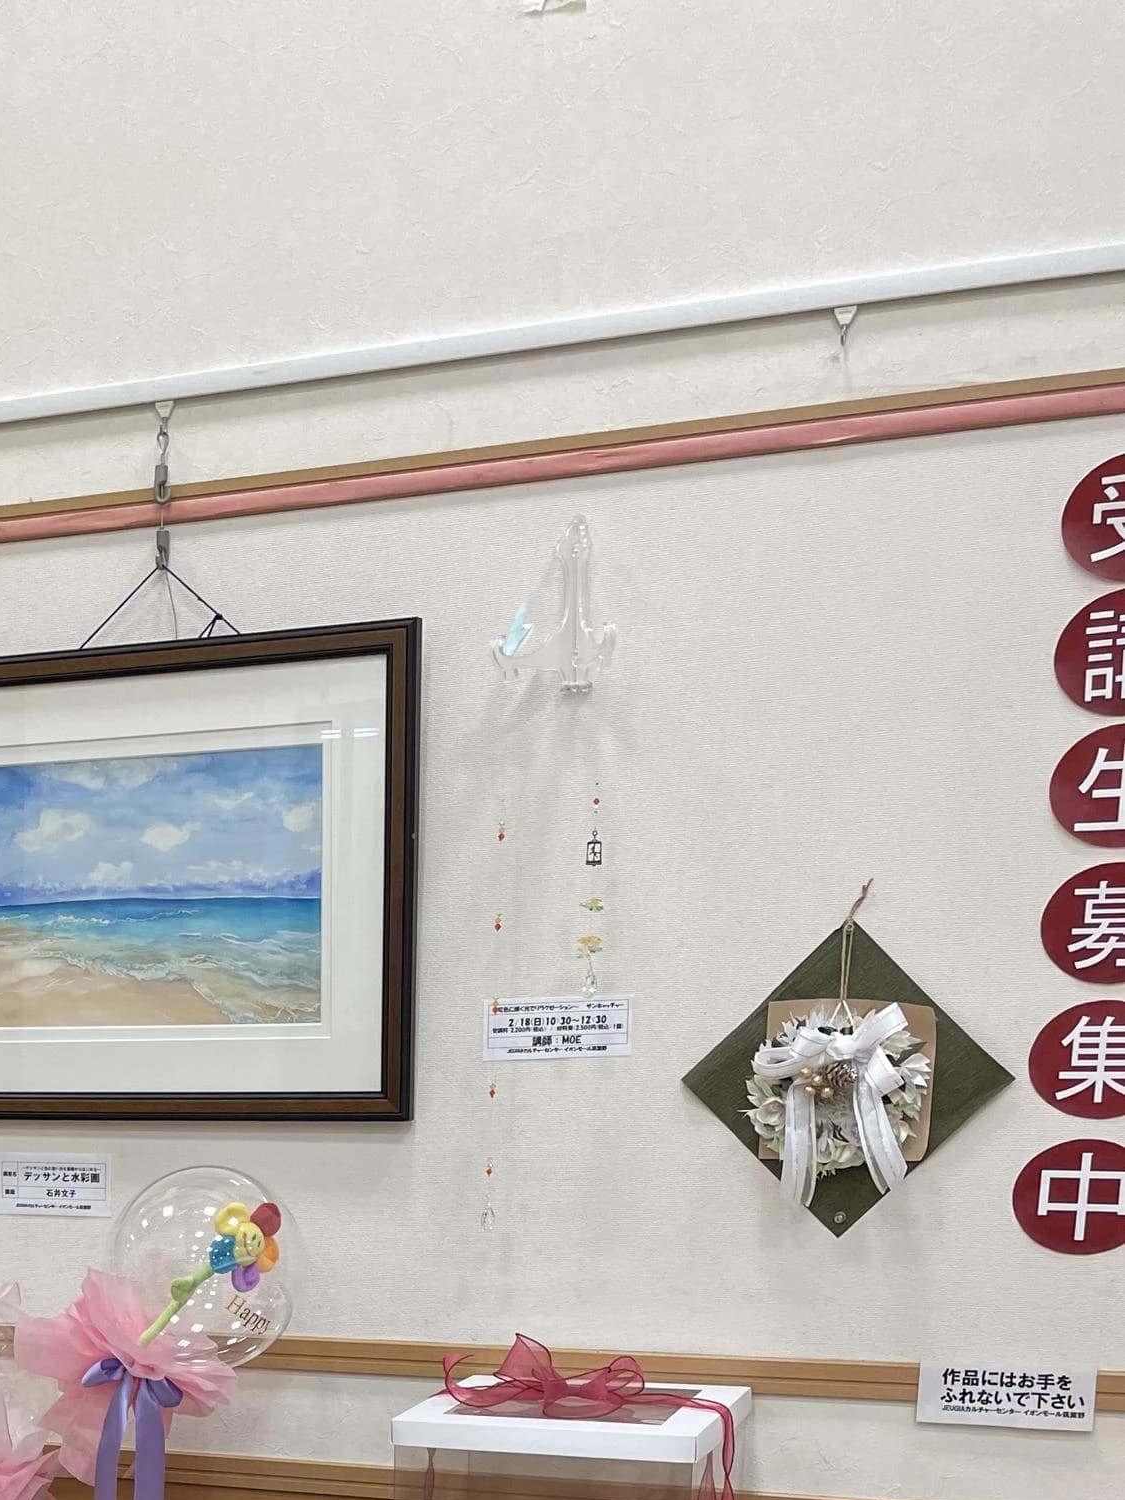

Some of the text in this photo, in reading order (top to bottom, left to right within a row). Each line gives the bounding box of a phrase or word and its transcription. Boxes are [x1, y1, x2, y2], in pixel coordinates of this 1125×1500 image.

[24, 1172, 100, 1183] デッサンと水彩画
[225, 1294, 271, 1336] Happy
[942, 1367, 1073, 1391] 作品にはお手を
[941, 1387, 1085, 1410] ふれないで下さい
